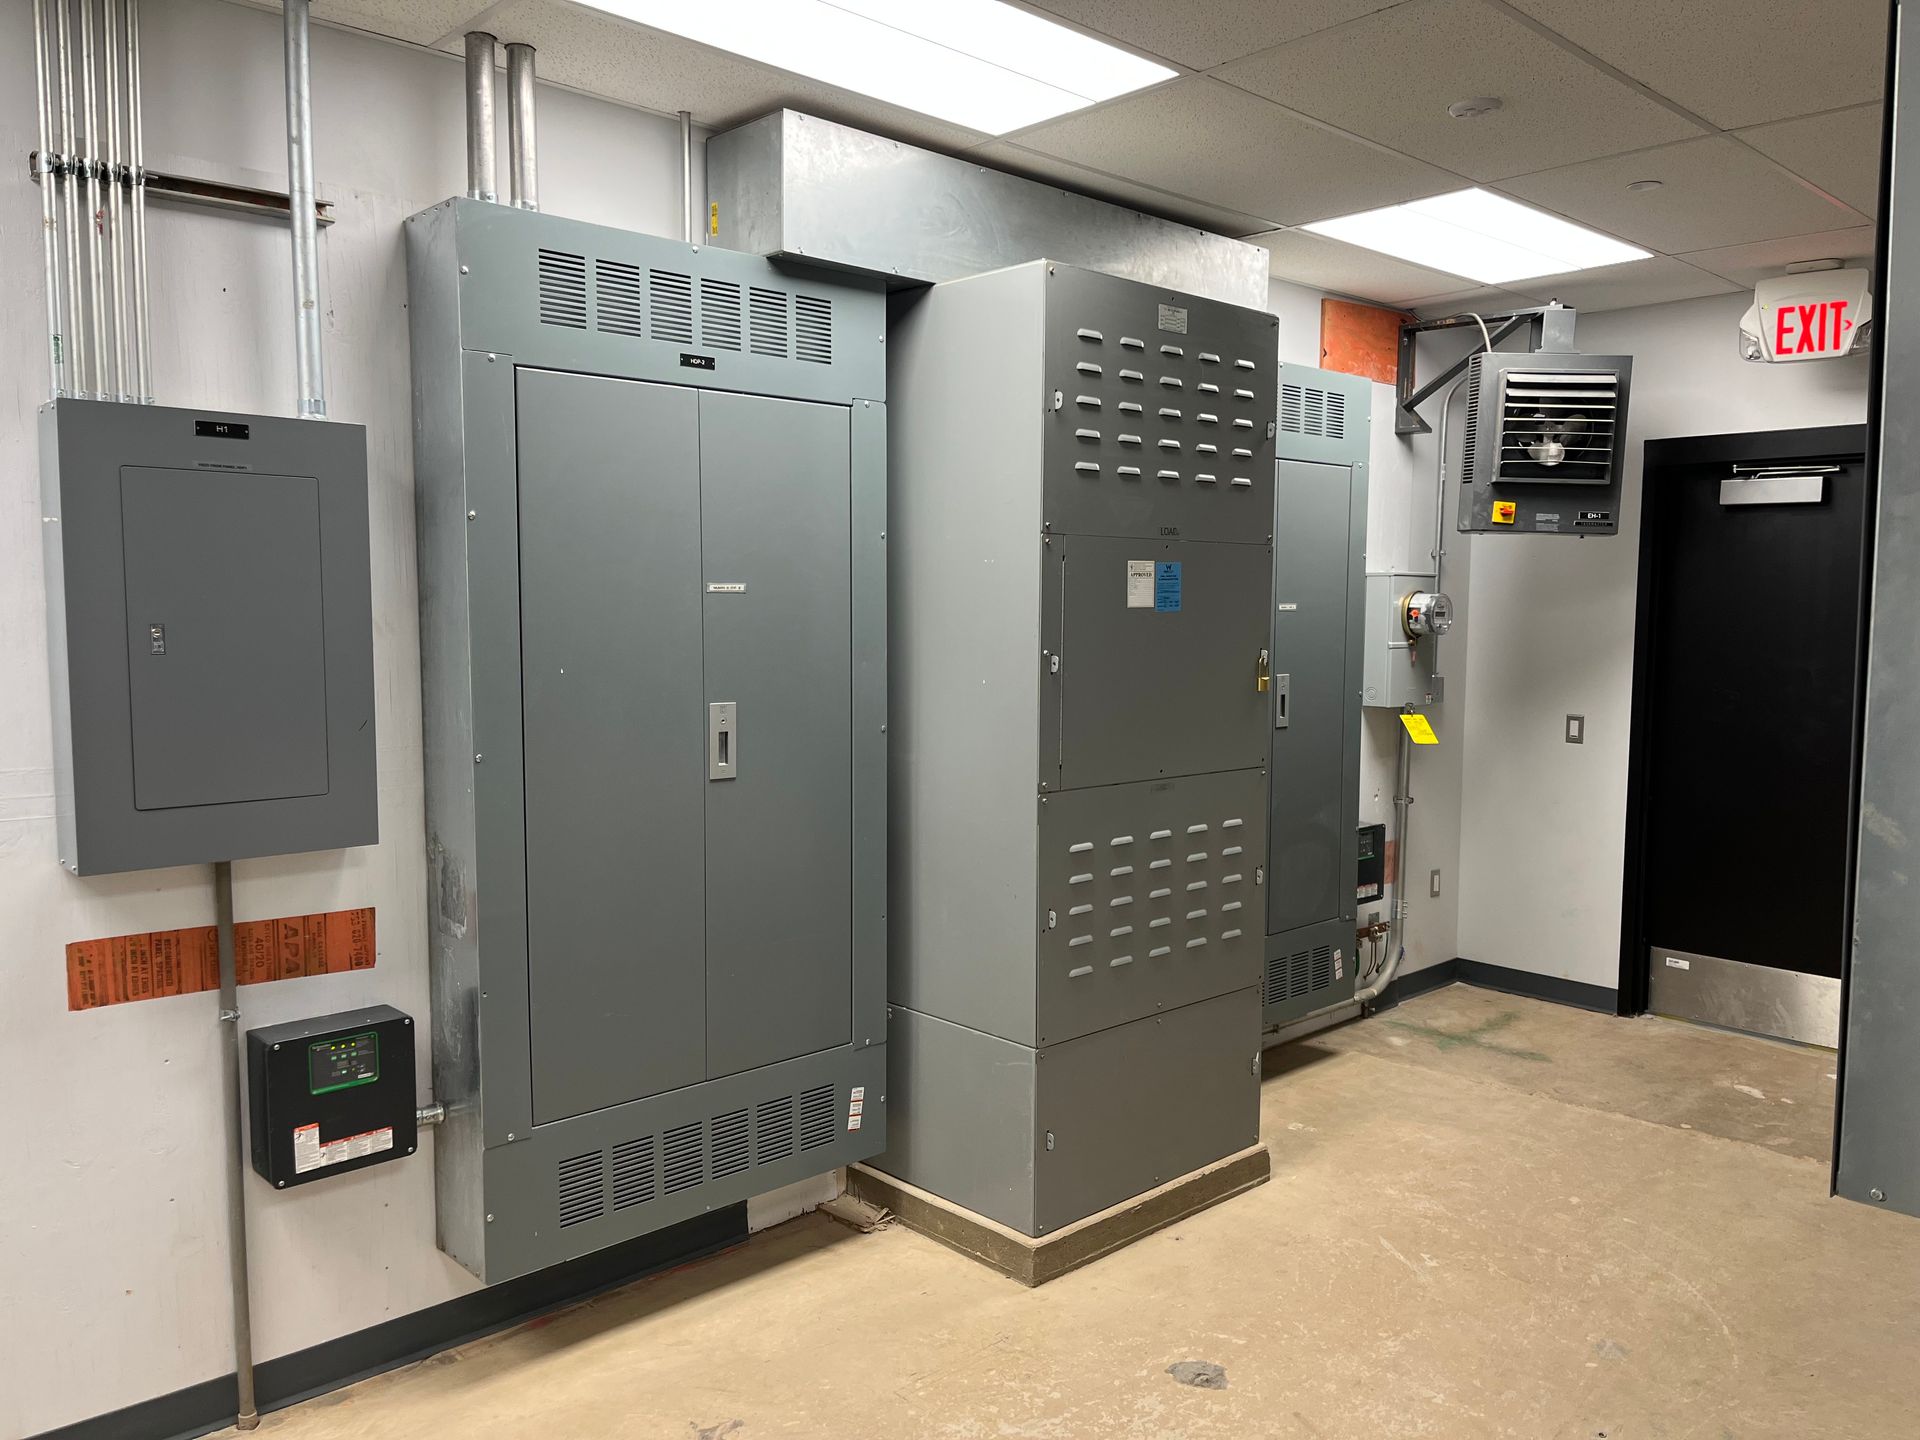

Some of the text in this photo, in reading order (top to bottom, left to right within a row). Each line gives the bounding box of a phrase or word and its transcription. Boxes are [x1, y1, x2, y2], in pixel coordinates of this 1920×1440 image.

[1776, 301, 1848, 355] EXIT
[216, 425, 228, 433] H1
[255, 936, 264, 968] 40/20
[284, 921, 299, 974] APA
